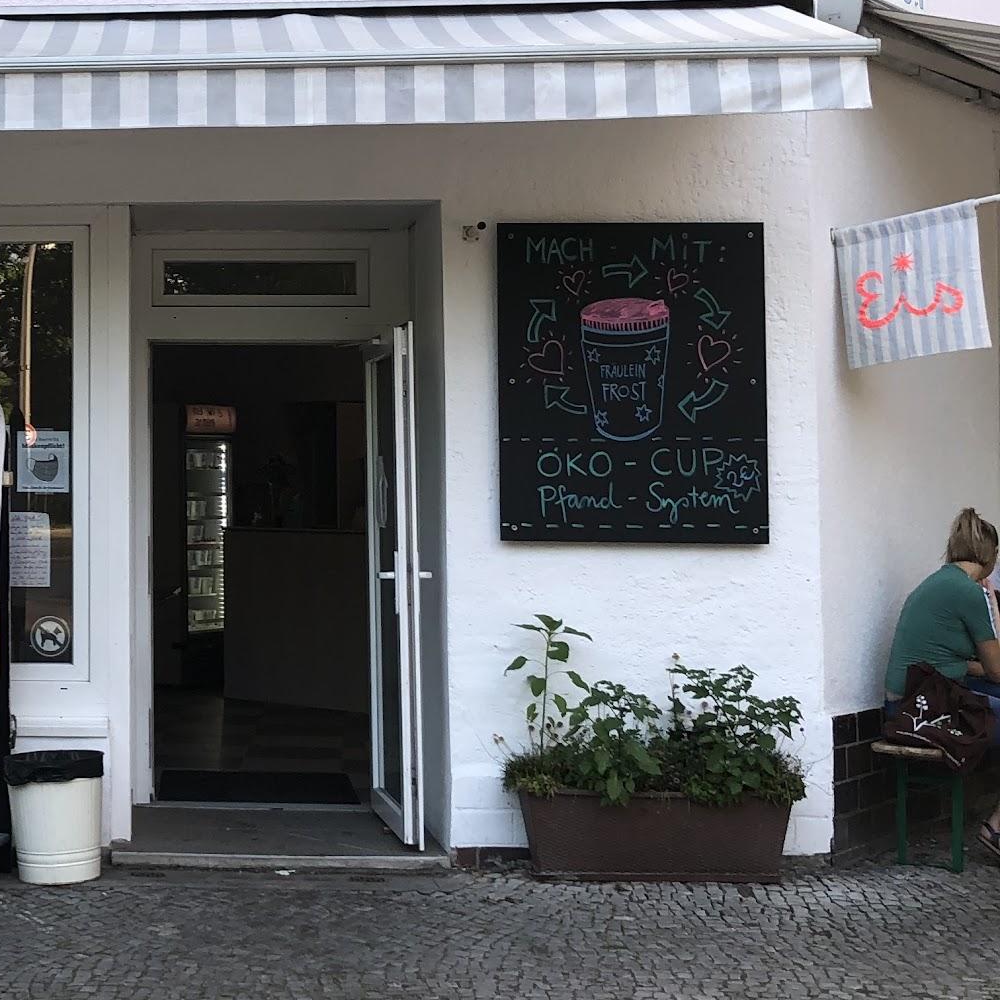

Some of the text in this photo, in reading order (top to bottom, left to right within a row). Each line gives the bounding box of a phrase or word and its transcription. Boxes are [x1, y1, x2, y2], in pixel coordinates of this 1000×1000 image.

[525, 236, 594, 264] MACH
[601, 381, 647, 402] FROST
[650, 447, 724, 477] CUP
[536, 481, 623, 523] Pfand
[646, 481, 740, 524] System
